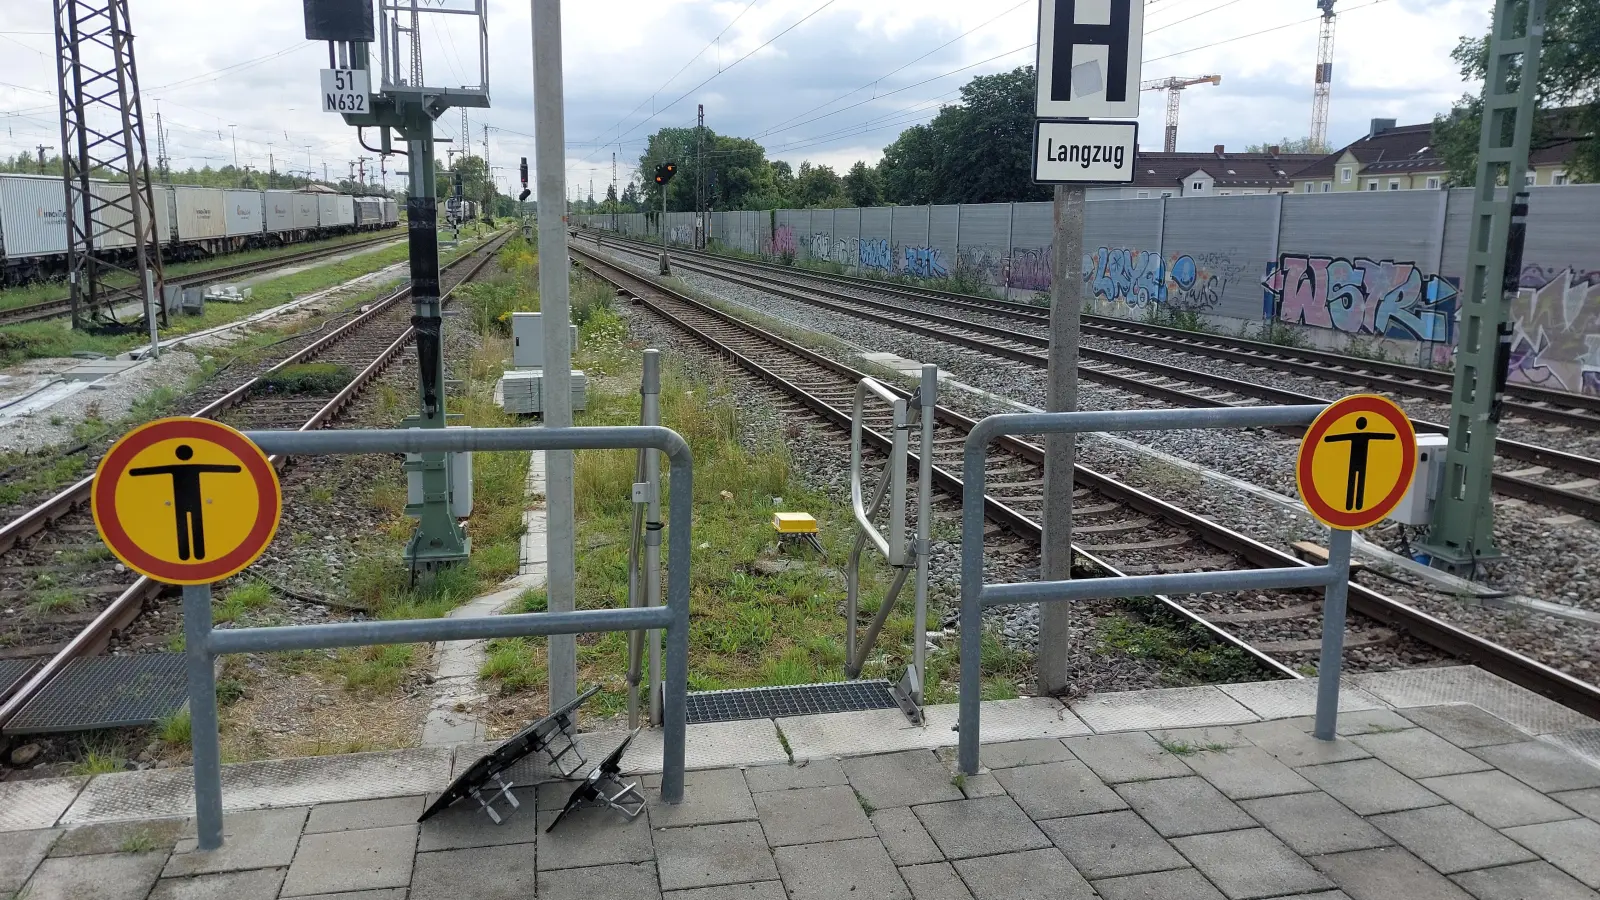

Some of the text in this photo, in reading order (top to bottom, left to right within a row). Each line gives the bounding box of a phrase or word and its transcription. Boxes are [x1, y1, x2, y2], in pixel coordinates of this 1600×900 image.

[1050, 0, 1130, 102] H
[335, 70, 354, 91] 51
[326, 93, 364, 111] N632
[1047, 137, 1125, 170] Langzug
